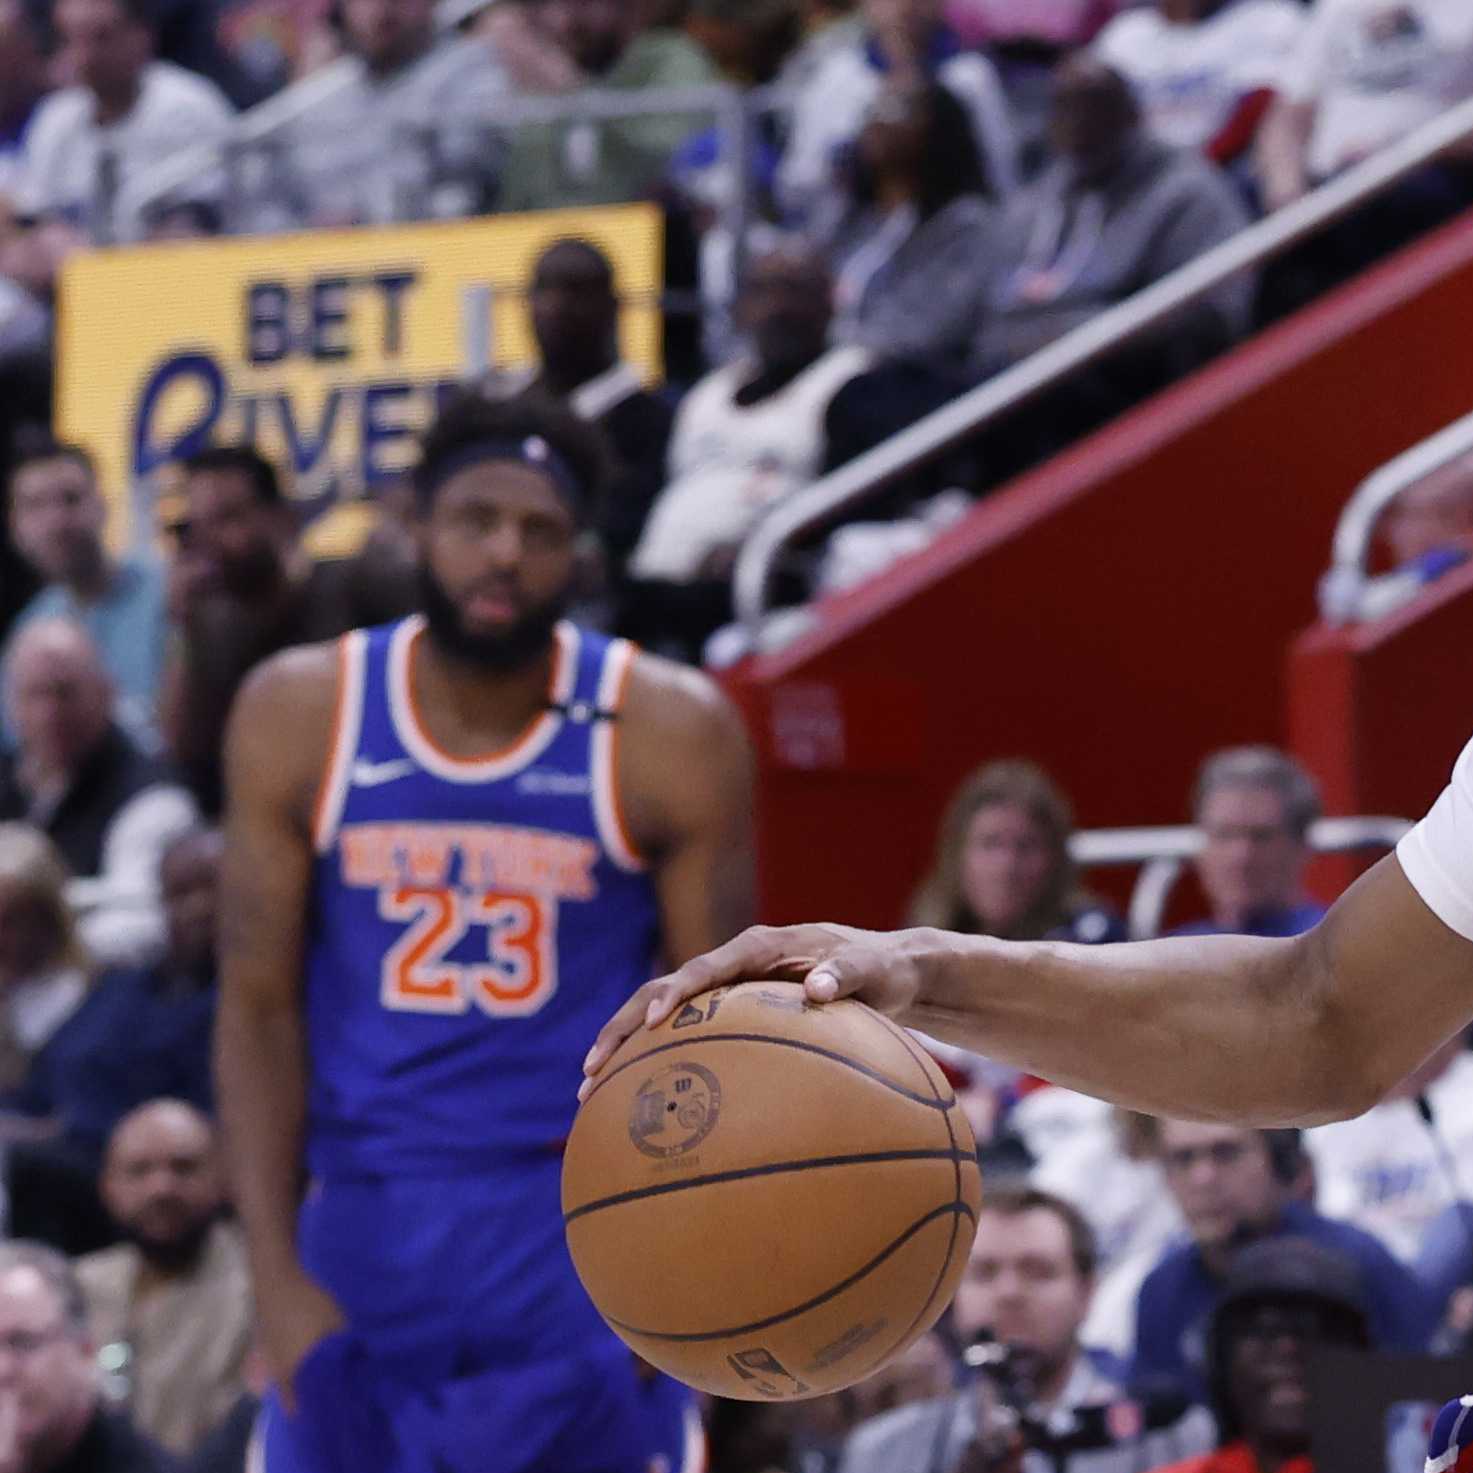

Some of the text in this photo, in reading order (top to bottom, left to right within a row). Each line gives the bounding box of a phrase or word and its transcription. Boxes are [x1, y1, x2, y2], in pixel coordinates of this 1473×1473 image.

[245, 269, 420, 365] BET
[340, 820, 598, 901] NEW YORK
[379, 884, 559, 1018] 23
